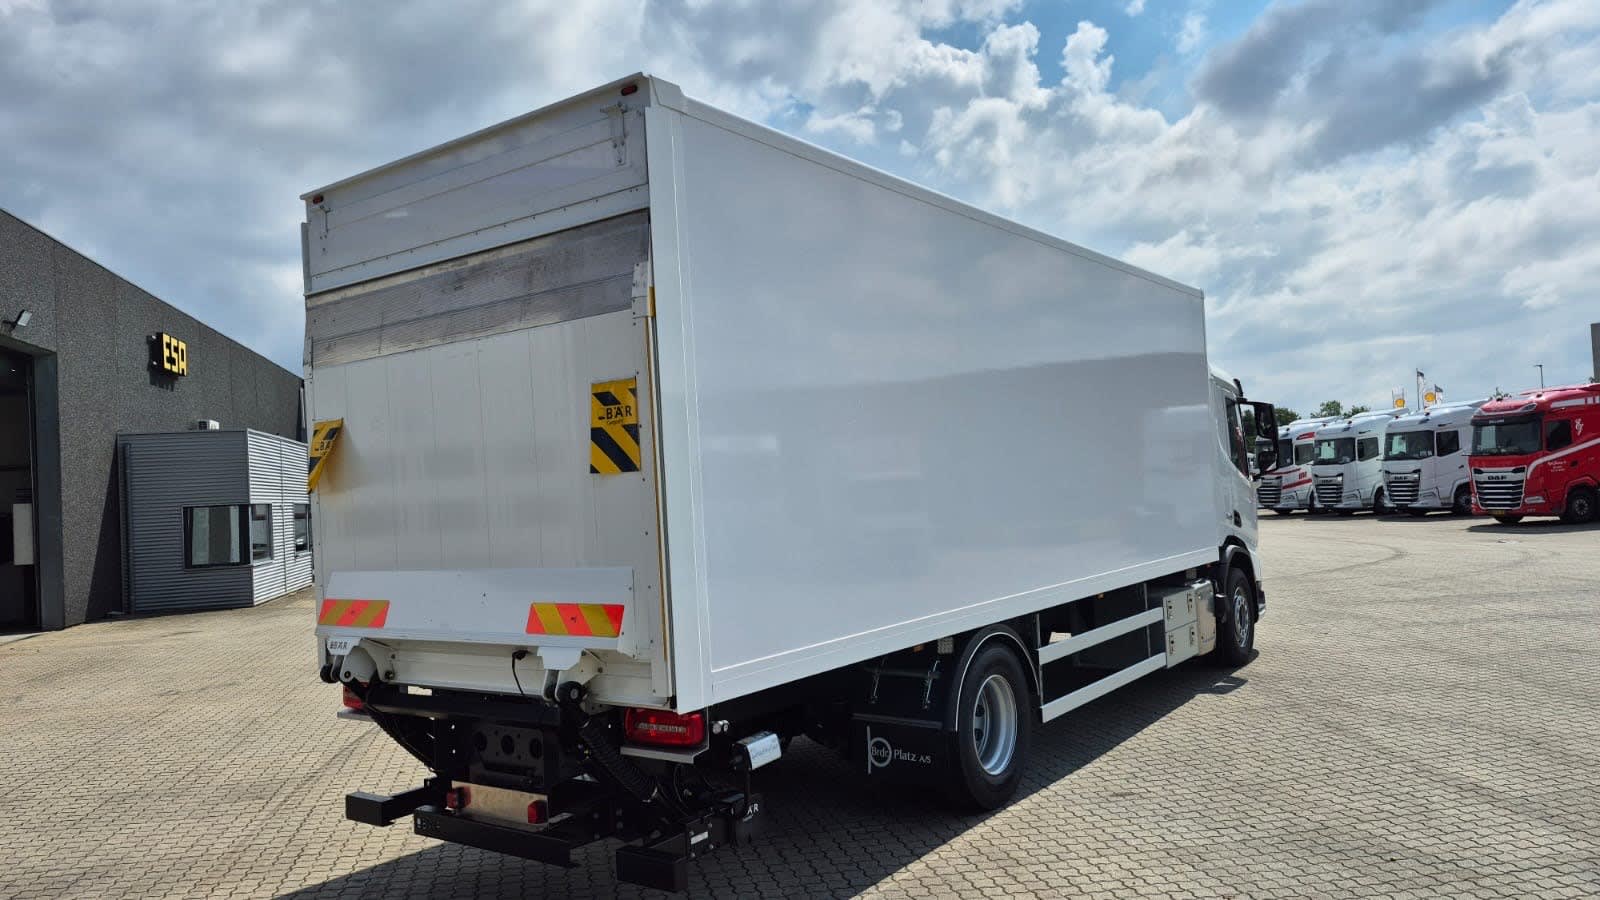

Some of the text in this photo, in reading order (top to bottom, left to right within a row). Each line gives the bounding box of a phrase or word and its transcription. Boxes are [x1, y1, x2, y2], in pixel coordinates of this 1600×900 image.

[162, 333, 187, 377] ESA
[606, 405, 632, 420] BÄR
[894, 748, 917, 762] Platz
